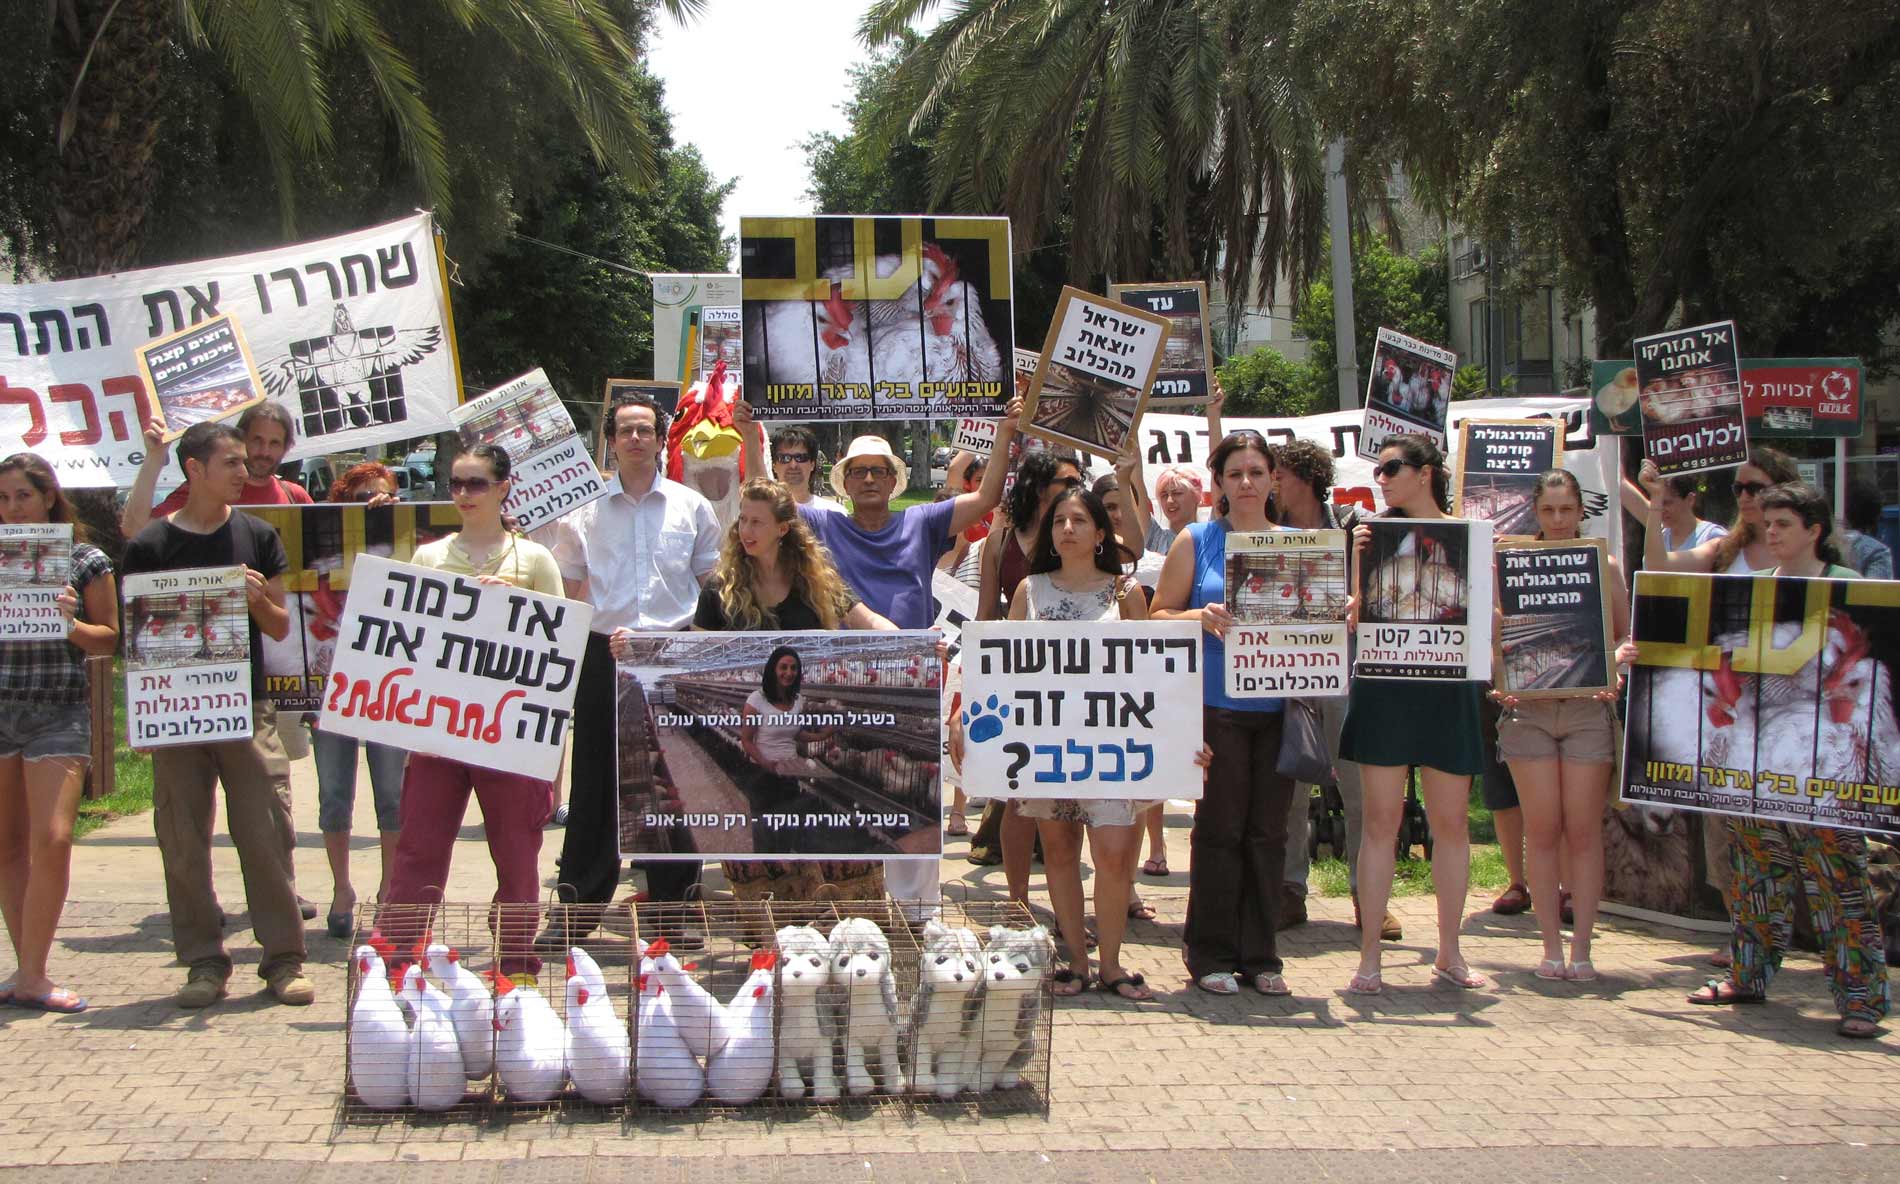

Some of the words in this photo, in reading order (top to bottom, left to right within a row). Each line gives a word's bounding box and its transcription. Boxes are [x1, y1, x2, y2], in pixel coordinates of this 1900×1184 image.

[254, 241, 418, 314] שחררו
[143, 281, 220, 337] את
[1147, 296, 1174, 311] עד
[708, 310, 739, 320] סוללה
[1083, 305, 1146, 337] ישראל
[188, 327, 230, 350] רוצים
[1078, 329, 1135, 356] יוצאת
[1403, 340, 1417, 349] כבר
[1701, 330, 1728, 347] אל
[150, 346, 185, 367] קצת
[191, 342, 234, 366] איכות
[1418, 345, 1442, 359] מדינות
[1641, 337, 1695, 360] תזרקו
[1016, 357, 1037, 369] לובי
[1064, 346, 1136, 380] מהכלוב
[1443, 352, 1453, 362] 30
[1661, 349, 1712, 371] אותנו
[155, 362, 188, 380] חיים
[767, 383, 813, 403] מזון!
[821, 383, 872, 399] גרגר
[874, 380, 912, 399] בלי
[918, 381, 1002, 399] שבועיים
[1761, 383, 1815, 398] זכויות
[752, 405, 794, 415] תרנגולות
[797, 405, 832, 414] הרעבת
[834, 404, 852, 415] חוק
[855, 404, 872, 414] לפי
[873, 404, 903, 413] להתיר
[905, 404, 931, 413] מנסה
[934, 402, 979, 414] החקלאות
[1368, 414, 1405, 434] סוללה
[1474, 428, 1546, 440] התרנגולת
[1649, 422, 1742, 457] לכלובים!
[1486, 444, 1533, 457] קודמת
[532, 447, 575, 472] שחררי
[1486, 458, 1531, 469] לביצה
[502, 460, 591, 513] התרנגולות
[1248, 536, 1274, 547] נוקד
[1283, 535, 1317, 545] אורית
[1505, 556, 1531, 569] את
[1535, 553, 1588, 567] שחררו
[152, 577, 179, 590] נוקד
[188, 575, 224, 586] אורית
[1505, 572, 1592, 588] התרנגולות
[383, 571, 482, 621] למה
[1518, 591, 1581, 609] מהצינוק
[508, 595, 566, 642] אז
[0, 621, 61, 633] מהכלובי
[351, 614, 426, 662] את
[1239, 631, 1269, 646] את
[1284, 632, 1333, 645] שחררי
[1375, 628, 1410, 647] קטן
[1418, 626, 1465, 645] כלוב
[436, 631, 576, 692] לעשות
[980, 638, 1090, 675] עושה
[1102, 638, 1197, 674] היית
[1233, 650, 1340, 669] התרנגולות
[1361, 648, 1398, 660] גדולה
[1403, 649, 1464, 662] התעללות
[141, 674, 172, 691] את
[186, 670, 238, 685] שחררי
[1235, 672, 1339, 692] מהכלובים!
[135, 691, 248, 716] התרנגולות
[328, 667, 527, 744] לתרנגולת?
[1014, 690, 1065, 727] זה
[1084, 691, 1155, 728] את
[515, 702, 571, 746] זה
[658, 712, 694, 727] עולם
[698, 714, 742, 726] מאסר
[745, 714, 763, 726] זה
[767, 711, 844, 726] התרנגולות
[849, 711, 896, 726] בשביל
[137, 715, 248, 740] מהכלובים!
[1002, 738, 1154, 790] לכלב?
[1646, 761, 1693, 783] מזון!
[1700, 767, 1753, 790] גרגר
[1758, 770, 1798, 794] בלי
[1629, 783, 1671, 797] תרנגולות
[1673, 789, 1710, 800] הרעבת
[1805, 777, 1900, 805] שבועיים
[1711, 794, 1730, 804] חוק
[1733, 795, 1750, 806] לפי
[1753, 798, 1785, 811] להתיר
[1787, 804, 1817, 815] מנסה
[1820, 806, 1873, 820] החקלאות
[645, 813, 719, 827] פוטו-אופ
[724, 814, 747, 831] רק
[762, 813, 800, 831] נוקד
[804, 813, 851, 827] אורית
[855, 810, 910, 827] בשביל
